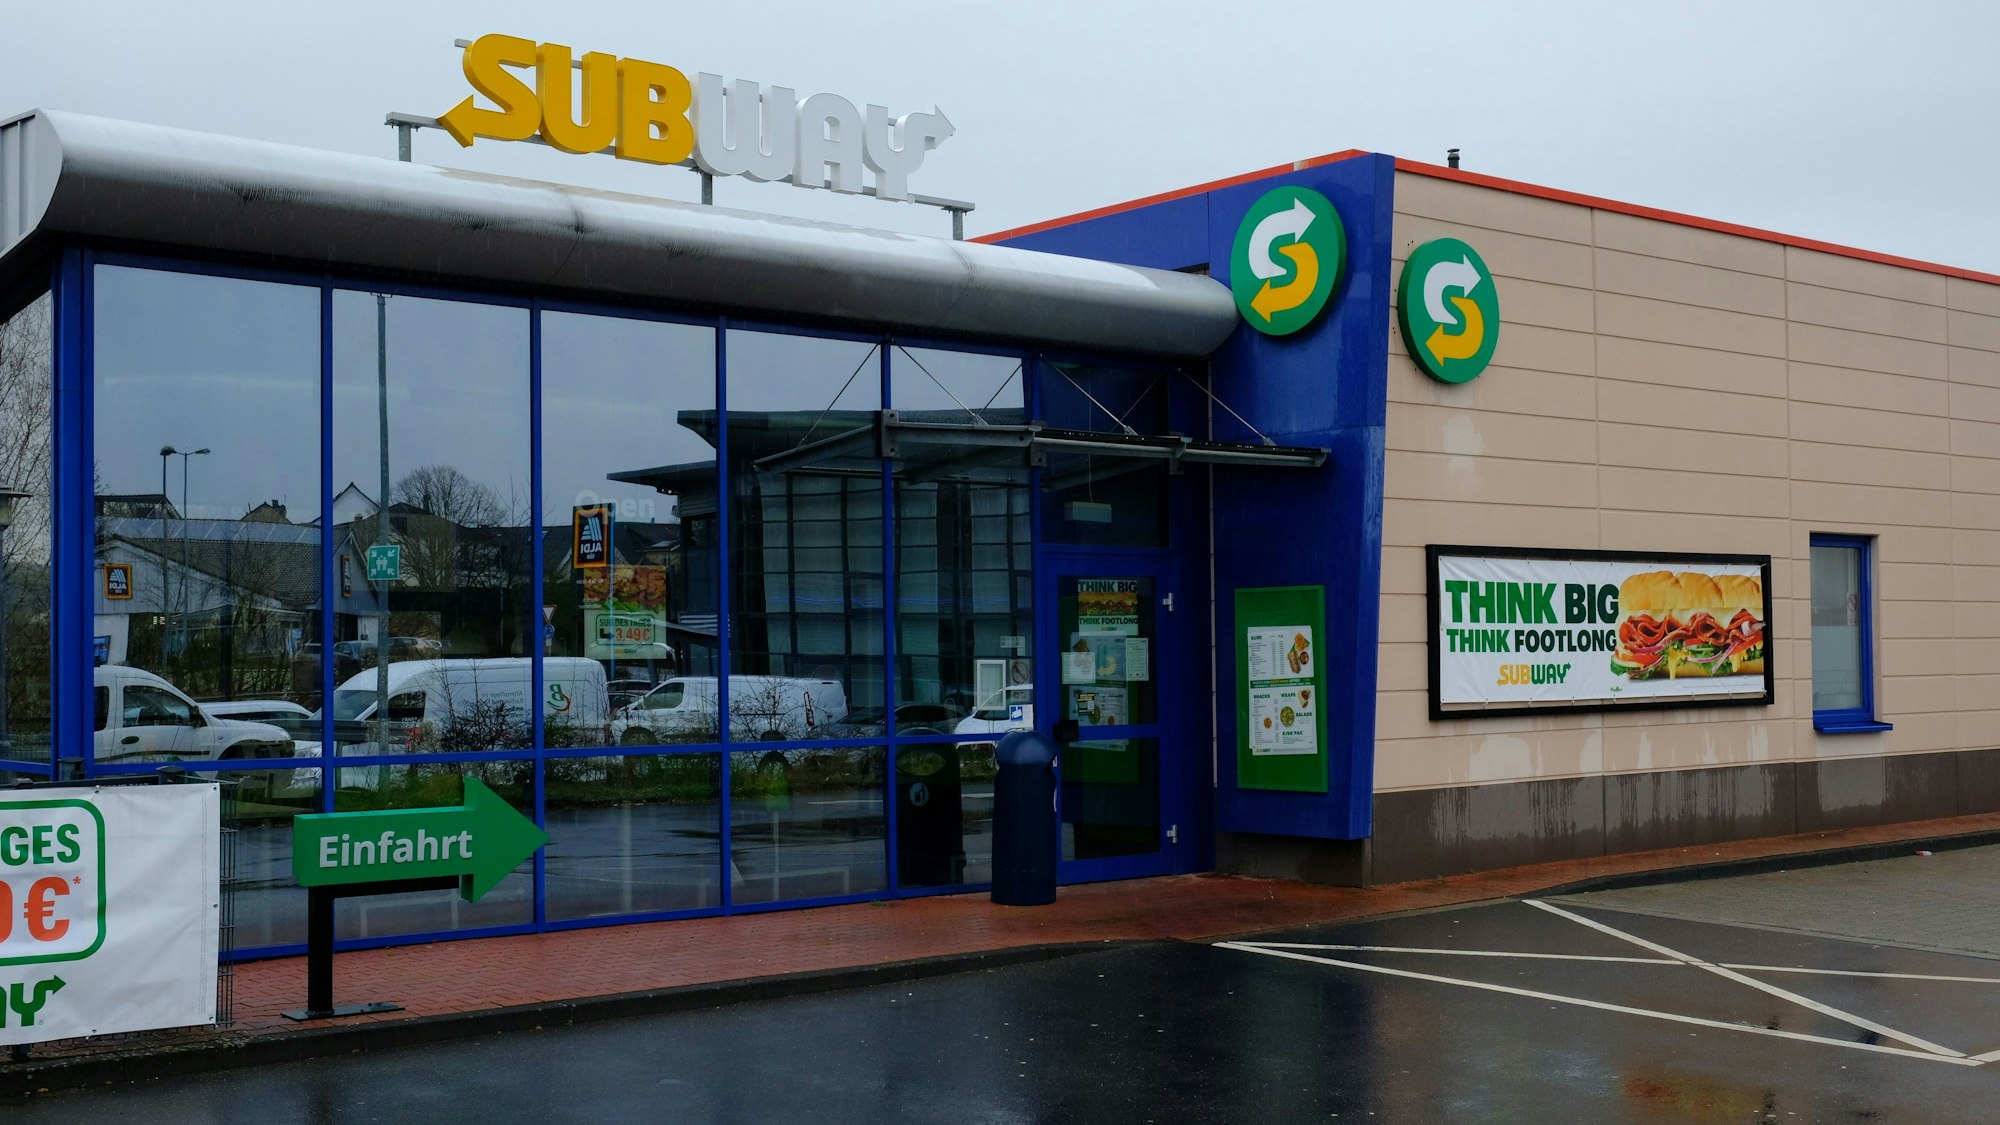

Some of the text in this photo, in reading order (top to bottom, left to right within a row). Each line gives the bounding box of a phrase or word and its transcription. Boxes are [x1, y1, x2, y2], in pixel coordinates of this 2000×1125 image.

[436, 33, 956, 202] SUBWAY
[575, 490, 655, 523] Open
[1079, 581, 1137, 592] THINK BIG
[1445, 580, 1620, 624] THINK BIG
[614, 618, 629, 626] DES
[1101, 617, 1140, 625] FOOTLONG
[1446, 628, 1618, 653] THINK FOOTLONG
[1497, 661, 1572, 686] SUBWAY
[319, 829, 473, 868] Einfahrt
